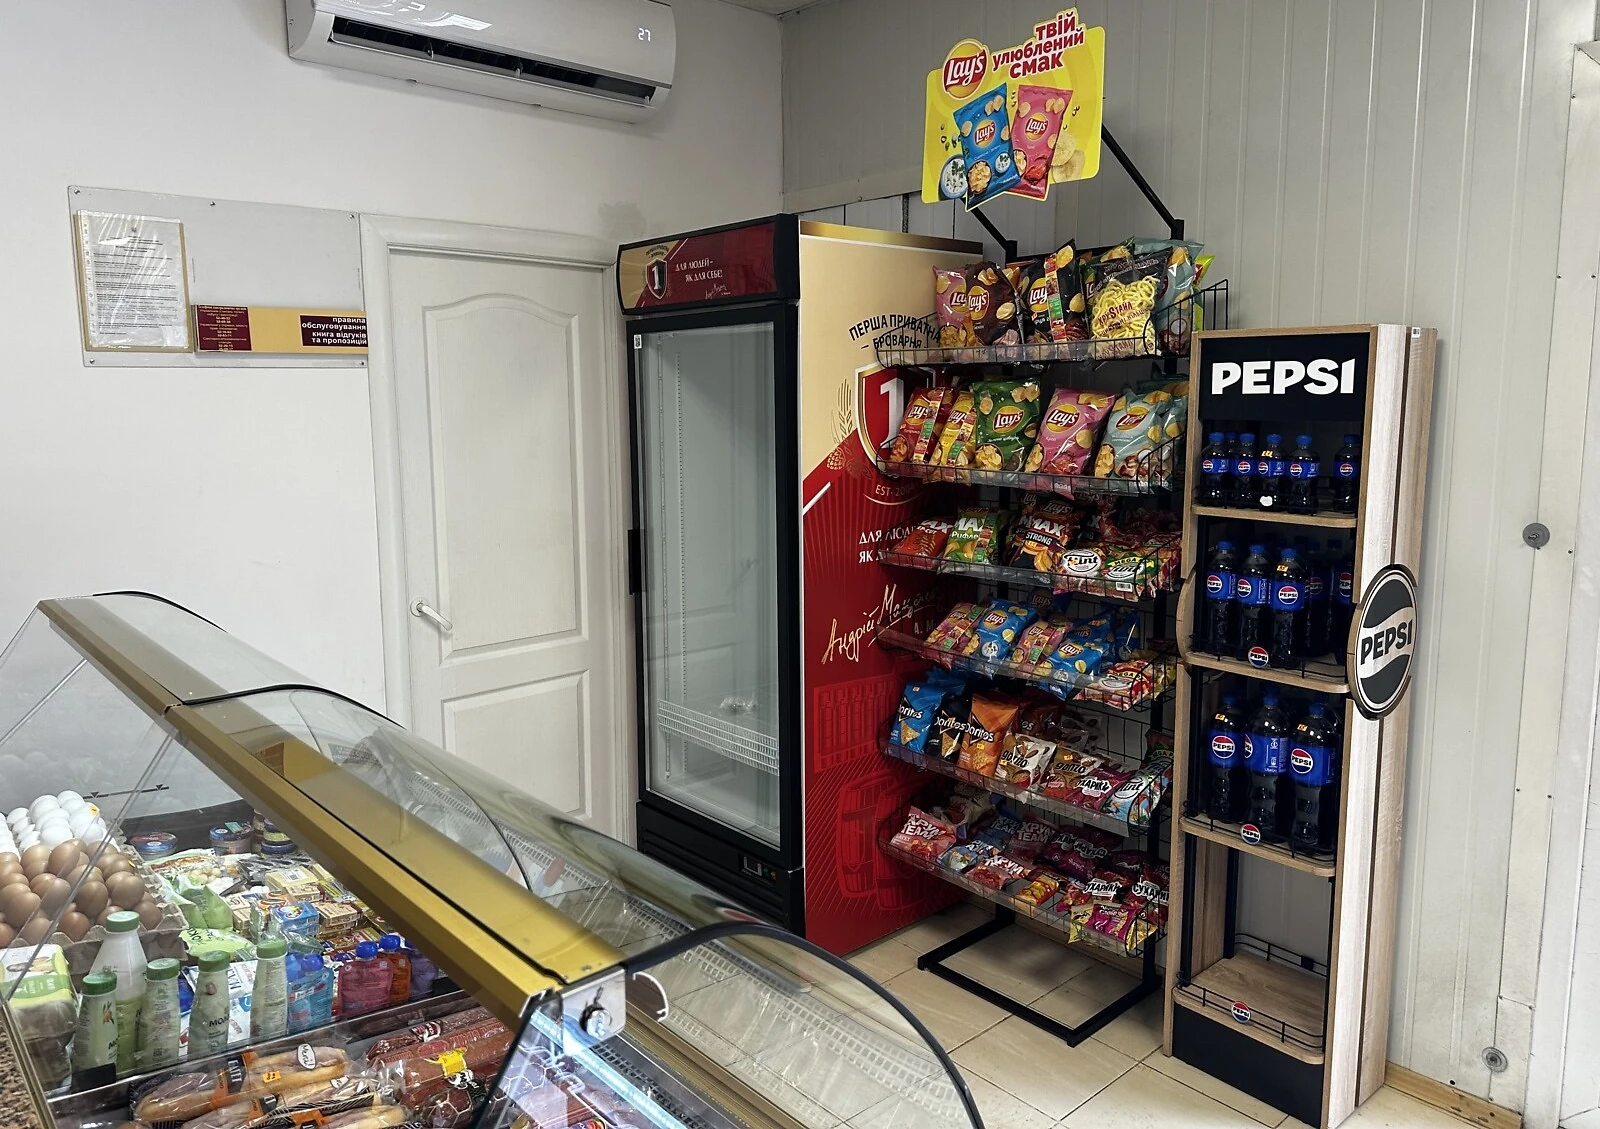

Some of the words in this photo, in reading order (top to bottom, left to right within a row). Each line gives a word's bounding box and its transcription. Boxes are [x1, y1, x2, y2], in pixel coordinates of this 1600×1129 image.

[638, 27, 651, 41] 27
[1035, 11, 1076, 41] твій
[992, 28, 1085, 71] улюблений
[946, 53, 985, 86] Lay's
[1009, 51, 1064, 79] смак
[975, 122, 996, 143] Lay's
[1025, 118, 1048, 135] Lay's
[675, 262, 687, 272] ДЛЯ
[652, 265, 660, 290] 1
[685, 274, 694, 283] ЯК
[694, 271, 706, 281] ДЛЯ
[706, 269, 723, 280] СЕБЕ!
[301, 321, 367, 331] обслуговування
[849, 315, 888, 340] ПЕРША
[336, 331, 367, 340] відгуків
[872, 334, 922, 350] БРОВАРНЯ
[1211, 358, 1356, 395] PEPSI
[879, 376, 904, 448] 1
[995, 412, 1023, 428] Lay's
[1048, 409, 1079, 427] Lay's
[859, 530, 882, 545] ДЛЯ
[1025, 531, 1053, 546] STRONG
[859, 550, 873, 563] ЯК
[1360, 619, 1413, 666] PEPSI
[1250, 652, 1268, 661] PEPSI
[1213, 743, 1235, 751] PEPSI
[1291, 755, 1312, 767] PEPSI
[1242, 830, 1260, 839] PEPSI
[1232, 1007, 1250, 1017] PEPSI
